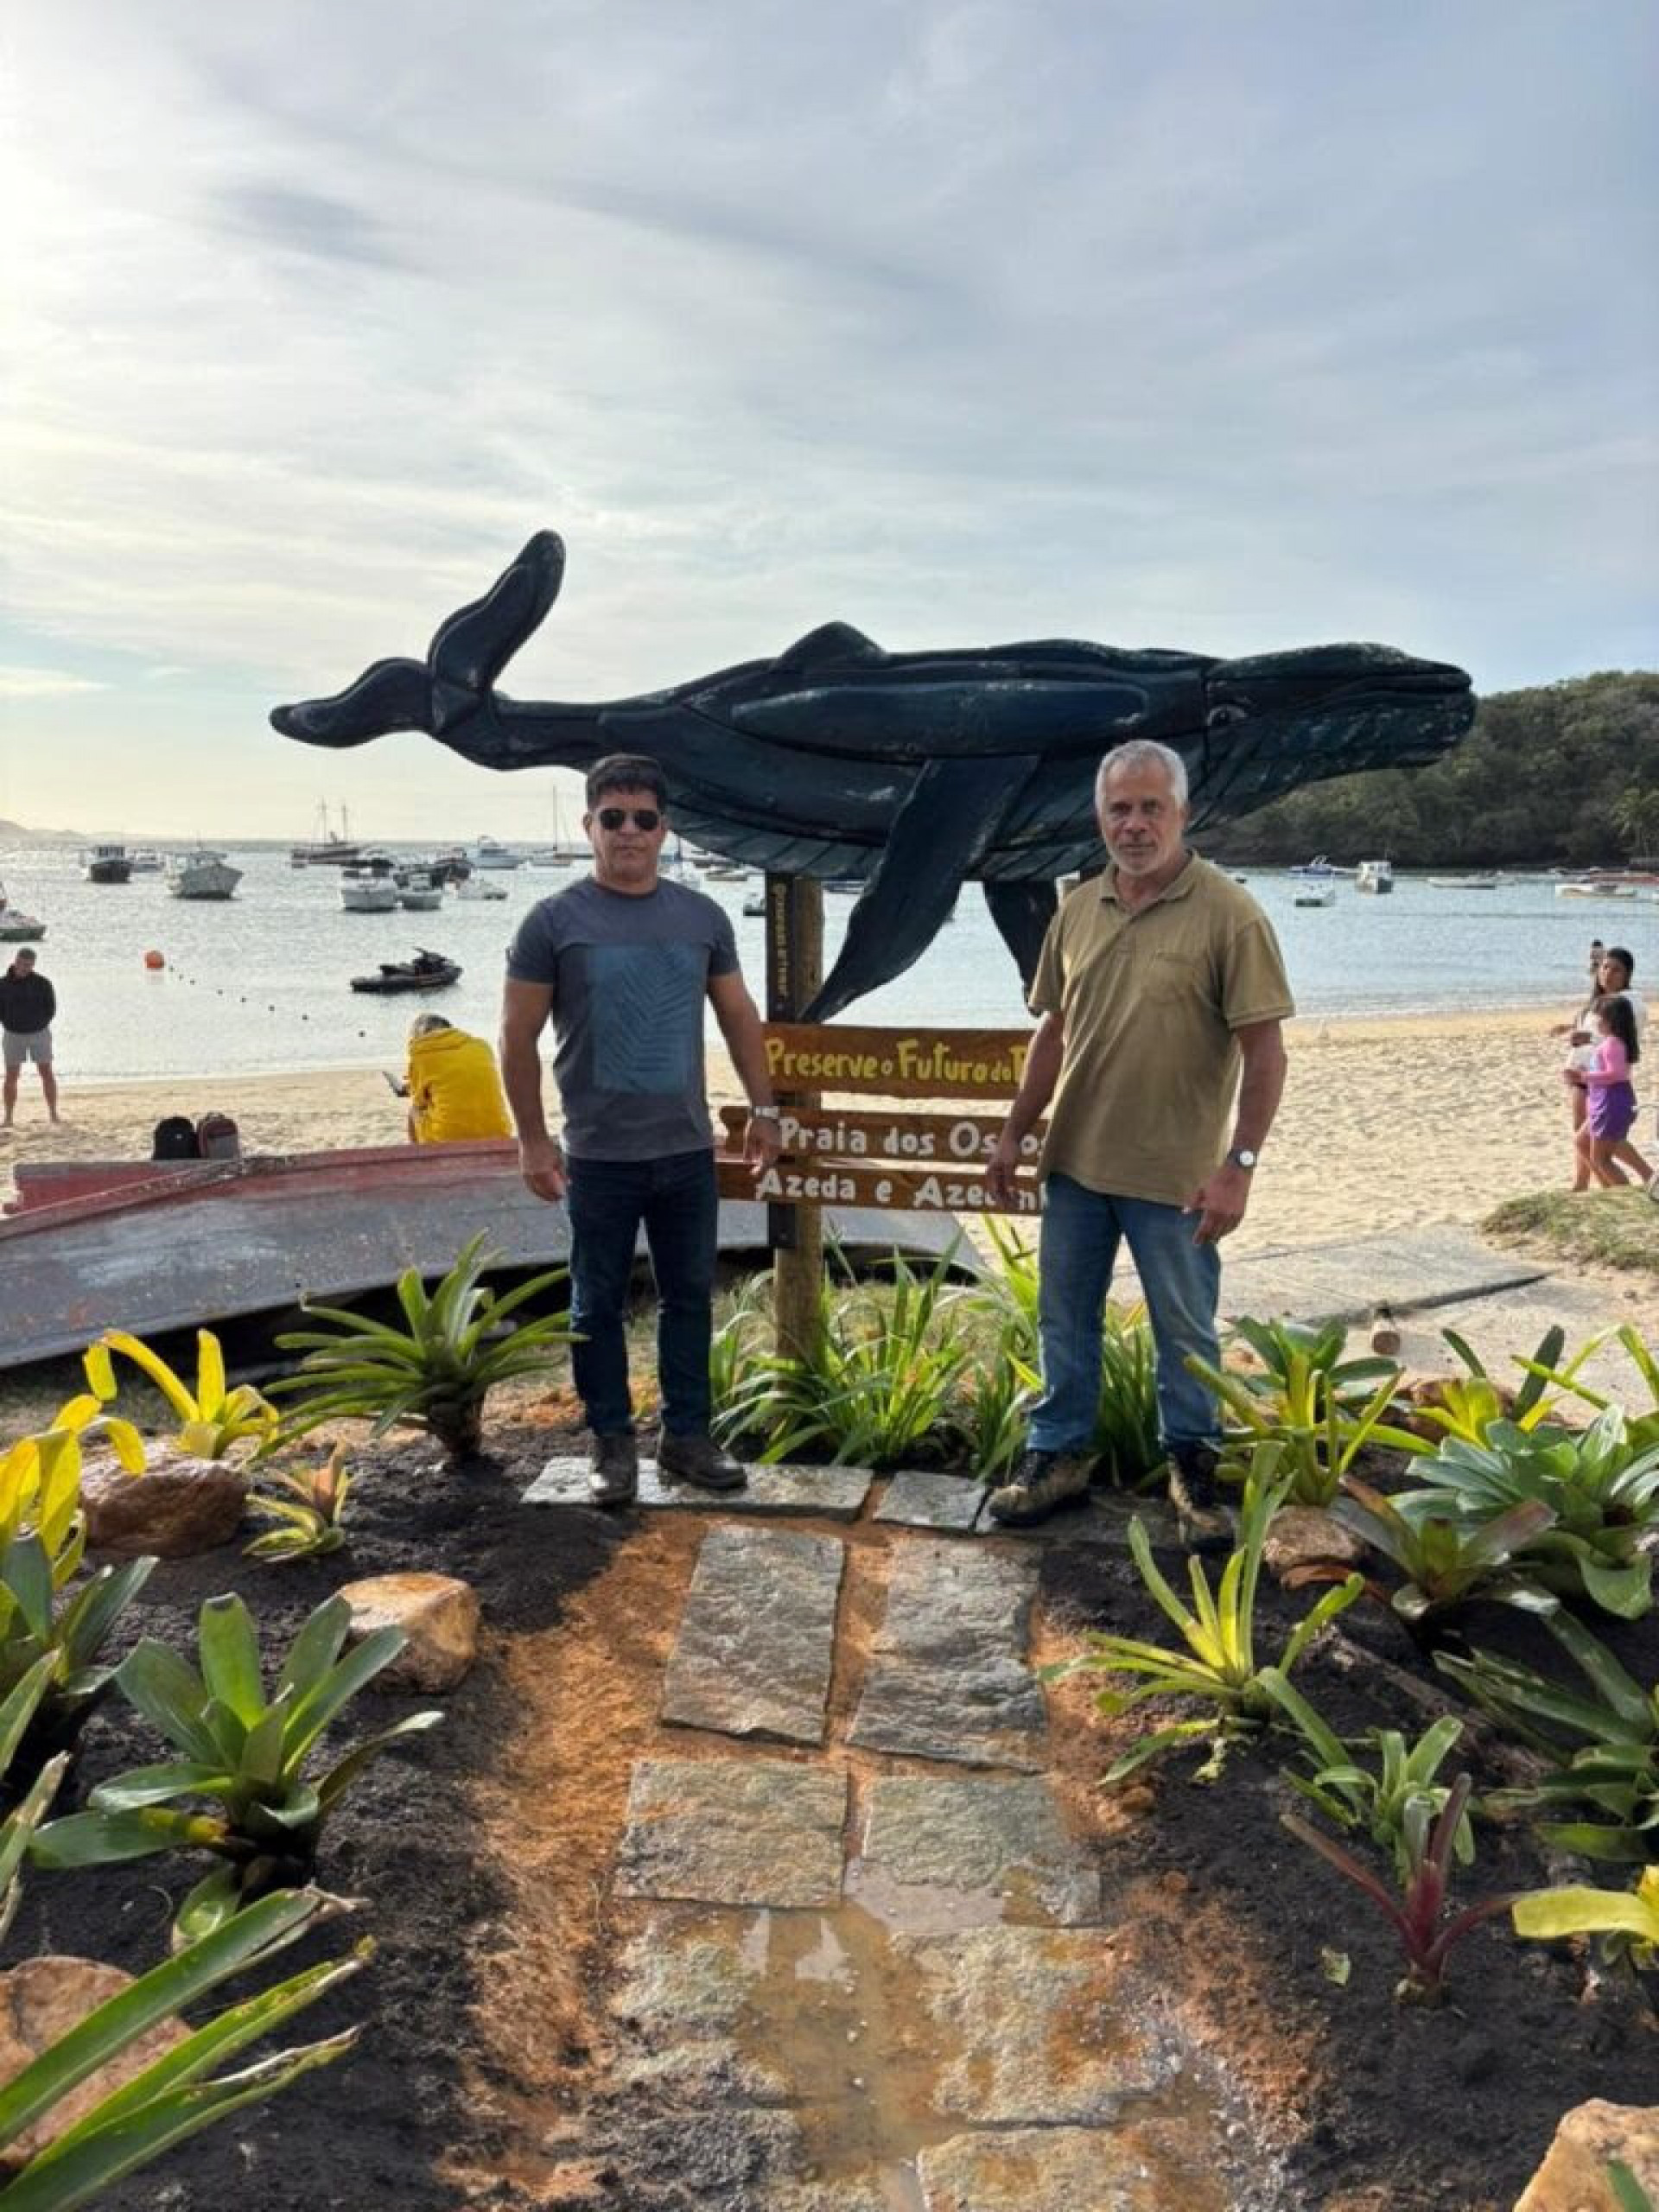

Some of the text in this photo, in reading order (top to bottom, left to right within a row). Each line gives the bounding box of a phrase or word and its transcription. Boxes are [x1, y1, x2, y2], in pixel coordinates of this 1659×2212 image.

[765, 1039, 879, 1079] Preserve
[880, 1058, 893, 1075] o
[896, 1039, 989, 1084] Futuro
[779, 1117, 1044, 1159] Praia dos Oso
[755, 1168, 856, 1200] Azeda
[875, 1180, 893, 1203] e
